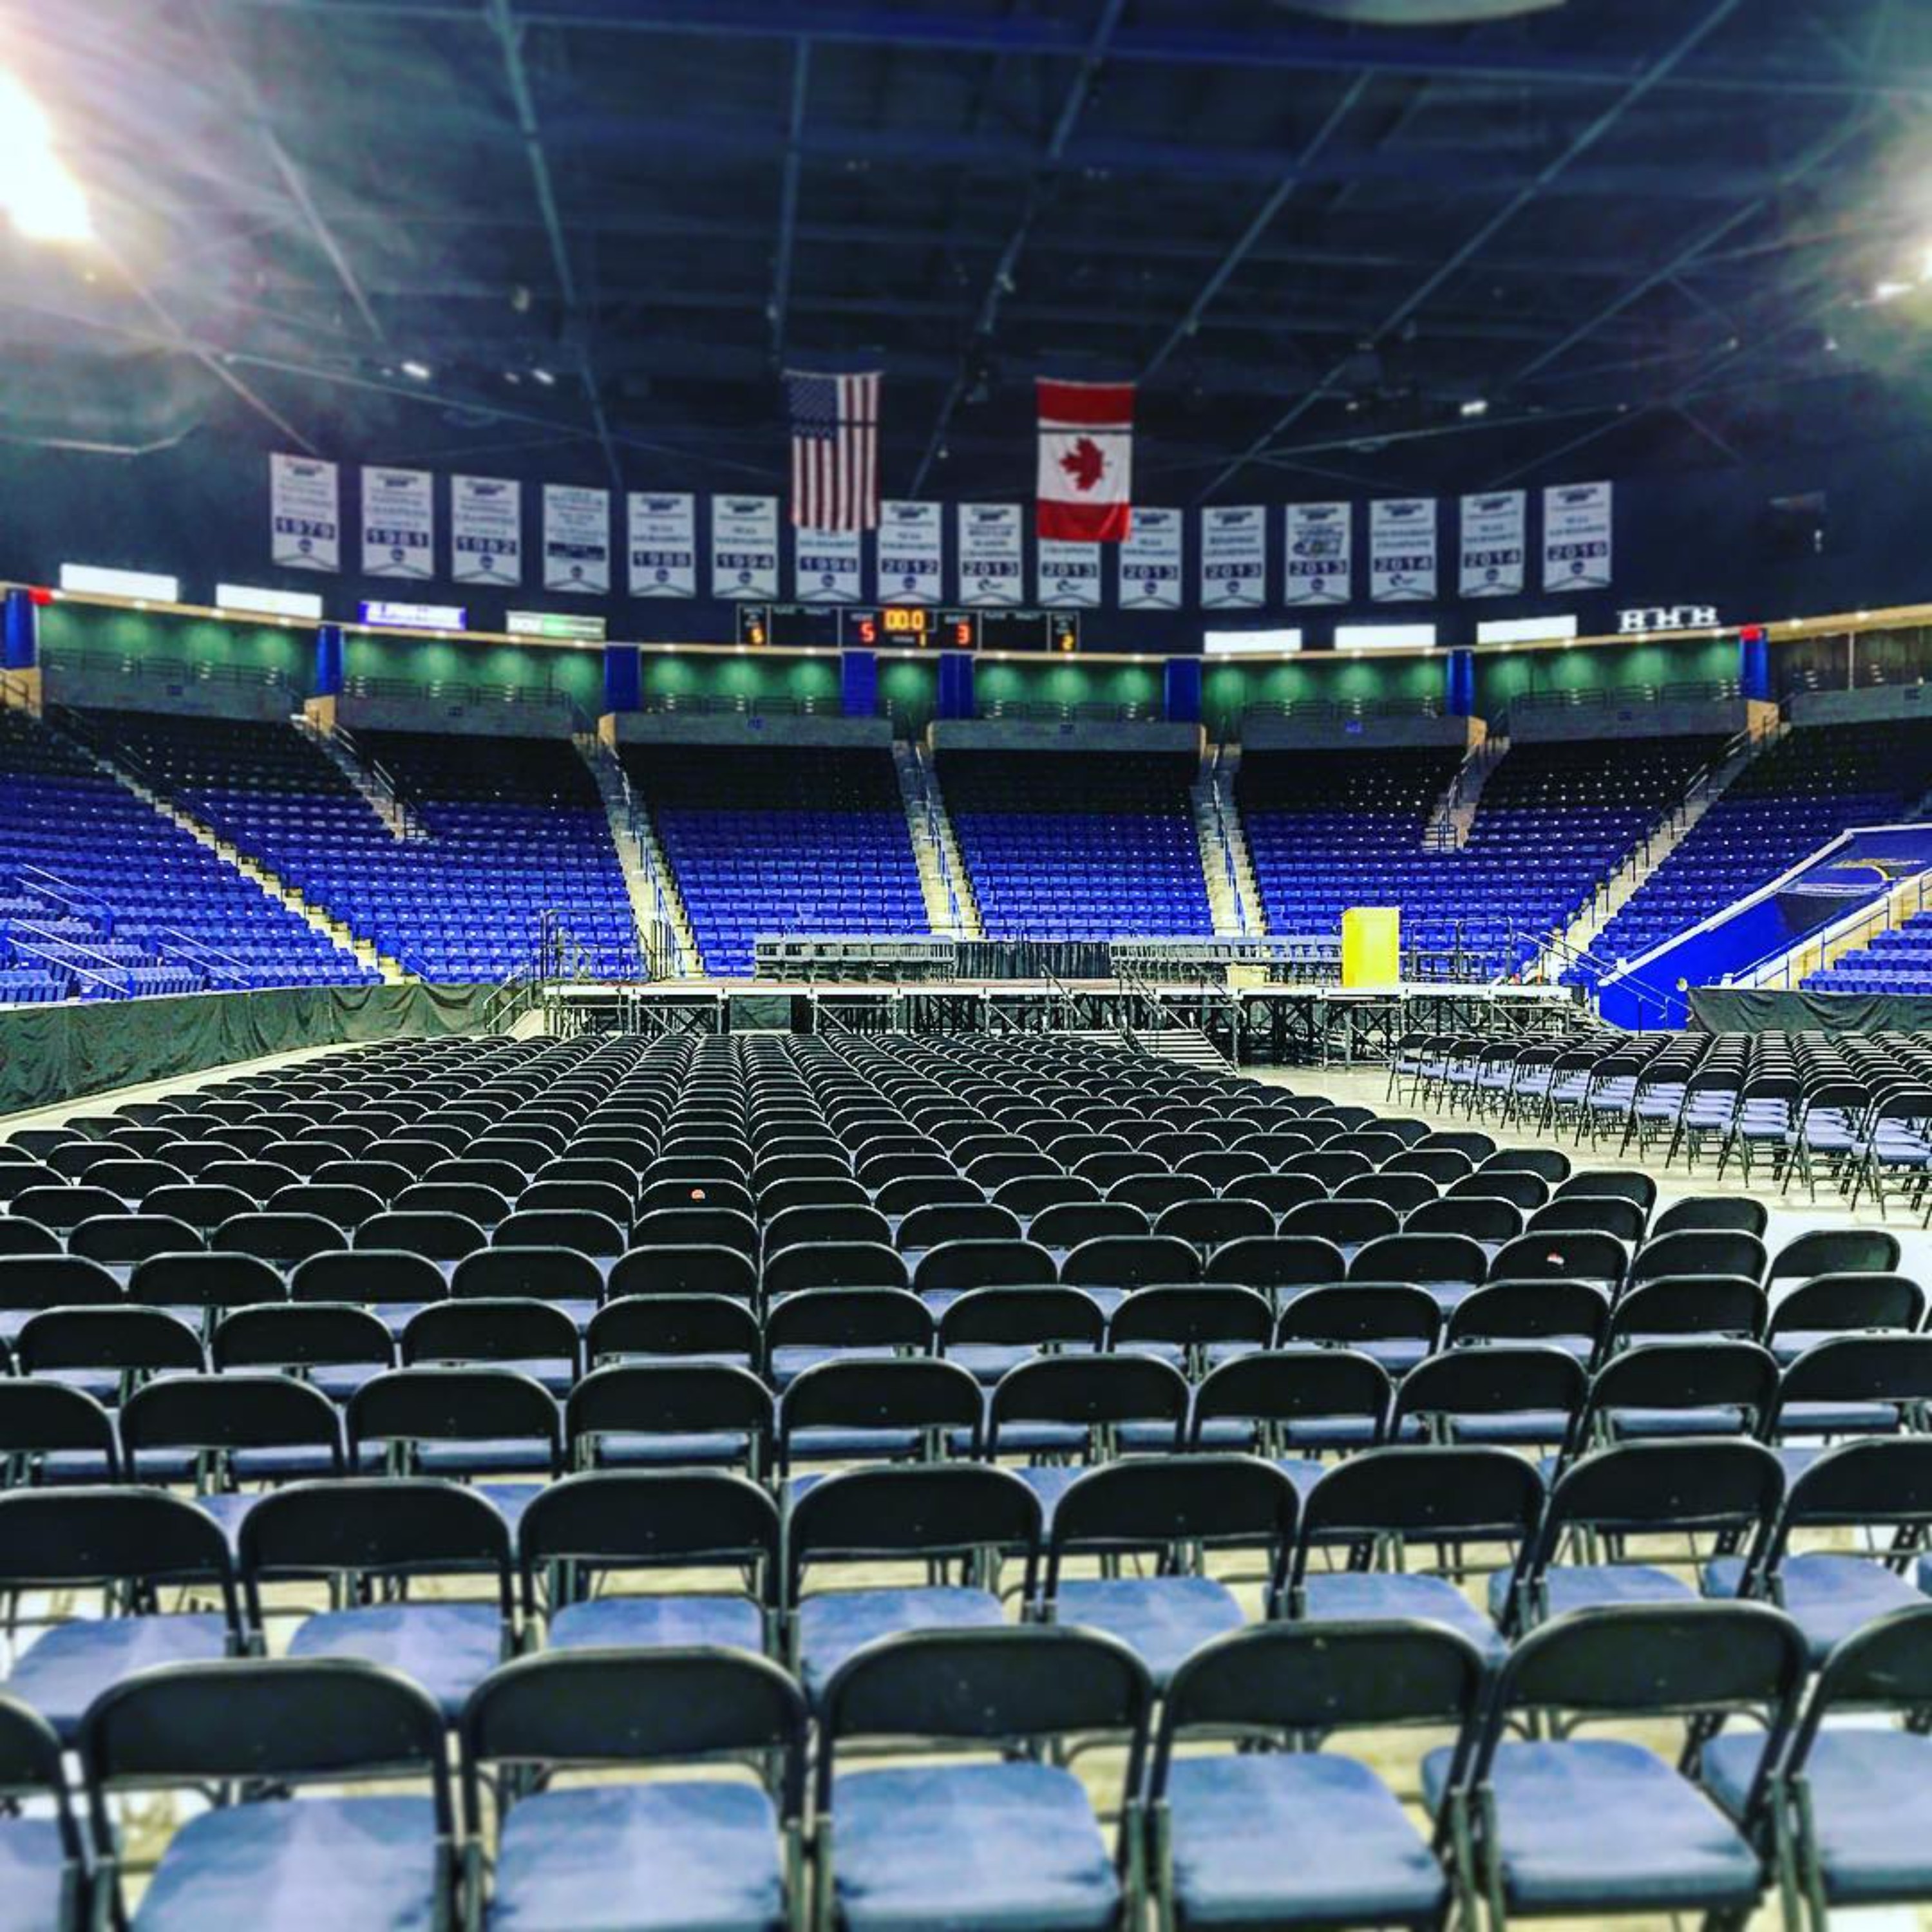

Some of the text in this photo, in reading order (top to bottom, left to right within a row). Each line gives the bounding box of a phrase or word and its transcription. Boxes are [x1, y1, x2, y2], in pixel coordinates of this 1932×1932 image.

[882, 560, 937, 574] 2012
[963, 562, 1018, 576] 2013
[1043, 564, 1097, 578] 2013
[1124, 565, 1177, 579] 2013
[1206, 564, 1261, 578] 2013
[861, 621, 875, 643] 5
[957, 625, 970, 645] 3
